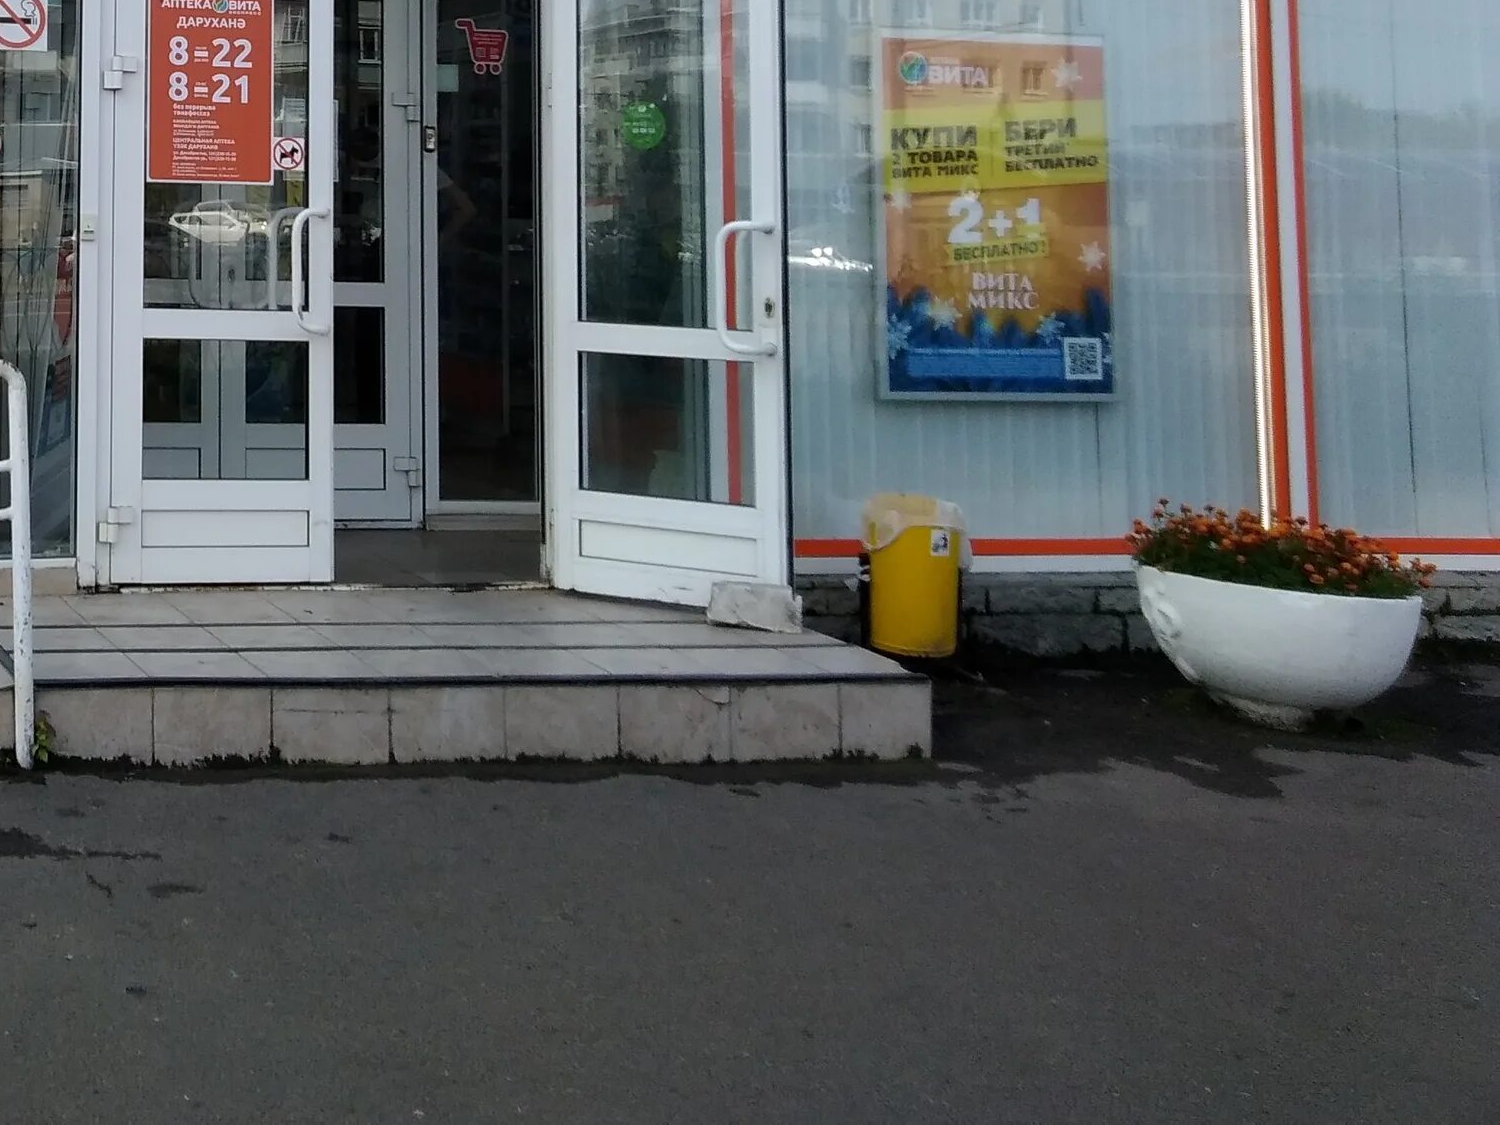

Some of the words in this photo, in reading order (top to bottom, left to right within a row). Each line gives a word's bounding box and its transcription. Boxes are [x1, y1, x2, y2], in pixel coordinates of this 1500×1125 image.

[228, 0, 261, 12] ВИТА
[176, 16, 246, 29] ДАРУХАНӘ
[928, 65, 988, 87] ВИТА
[891, 125, 978, 151] КУПИ
[1005, 117, 1076, 142] БЕРИ
[907, 150, 979, 165] ТОВАРА
[937, 163, 979, 176] МИКС
[972, 273, 1034, 291] ВИТА
[968, 291, 1040, 310] МИКС
